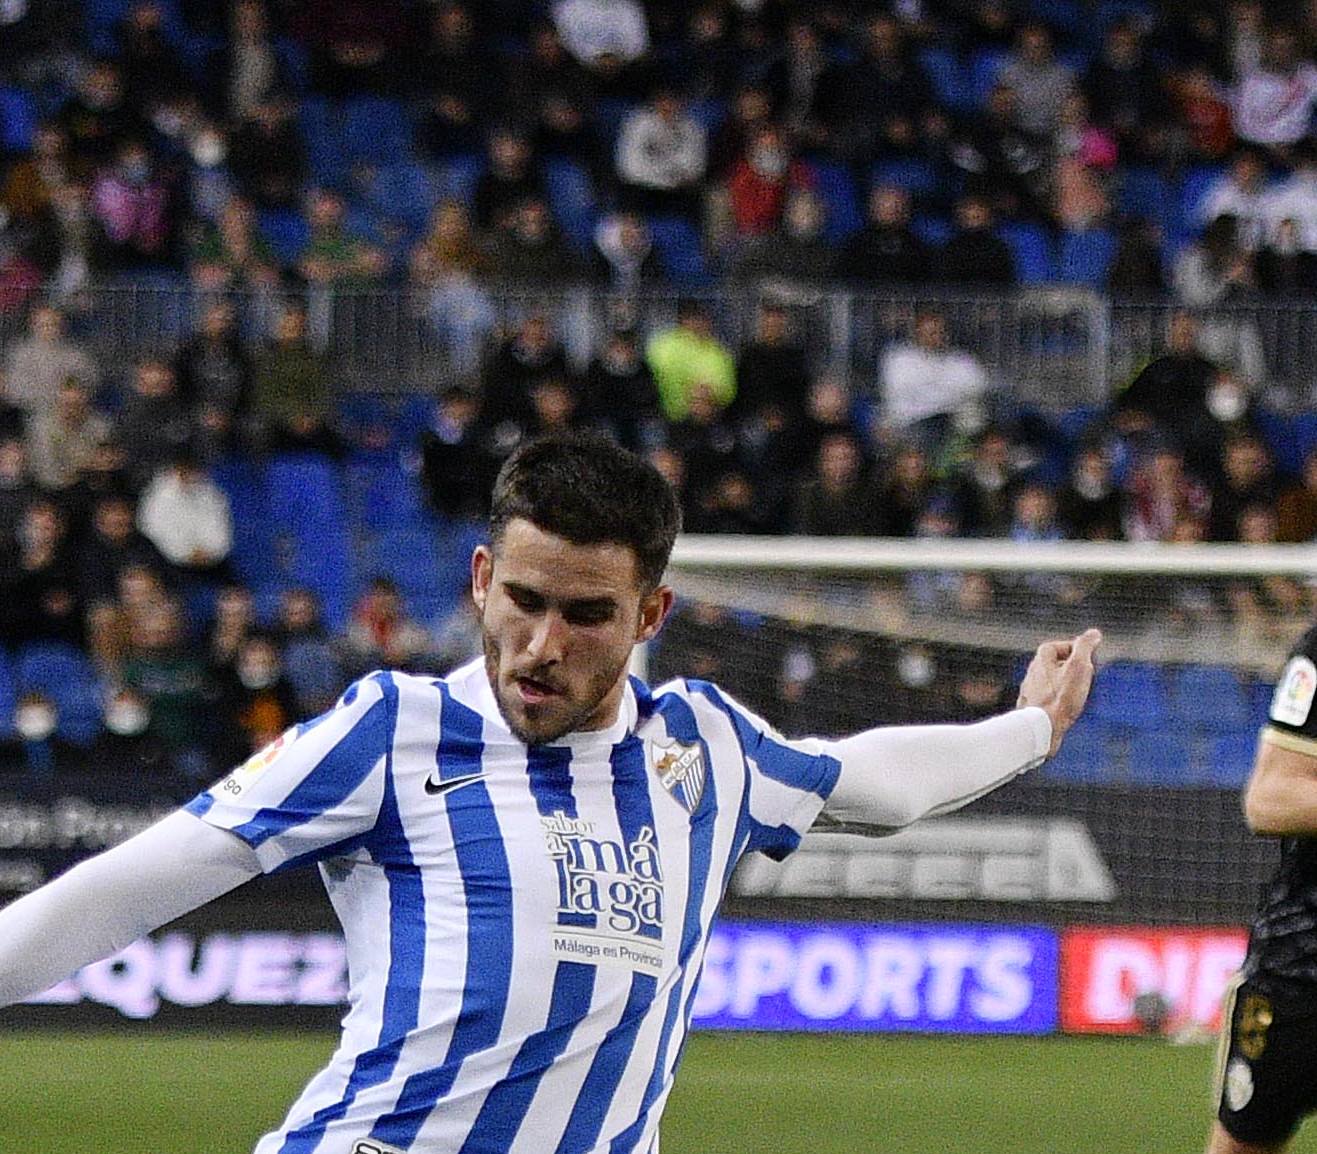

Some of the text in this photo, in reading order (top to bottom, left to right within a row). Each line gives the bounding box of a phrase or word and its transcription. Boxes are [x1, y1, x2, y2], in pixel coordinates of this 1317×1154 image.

[540, 810, 596, 834] sabor
[554, 938, 601, 958] Málaga
[603, 948, 618, 959] es
